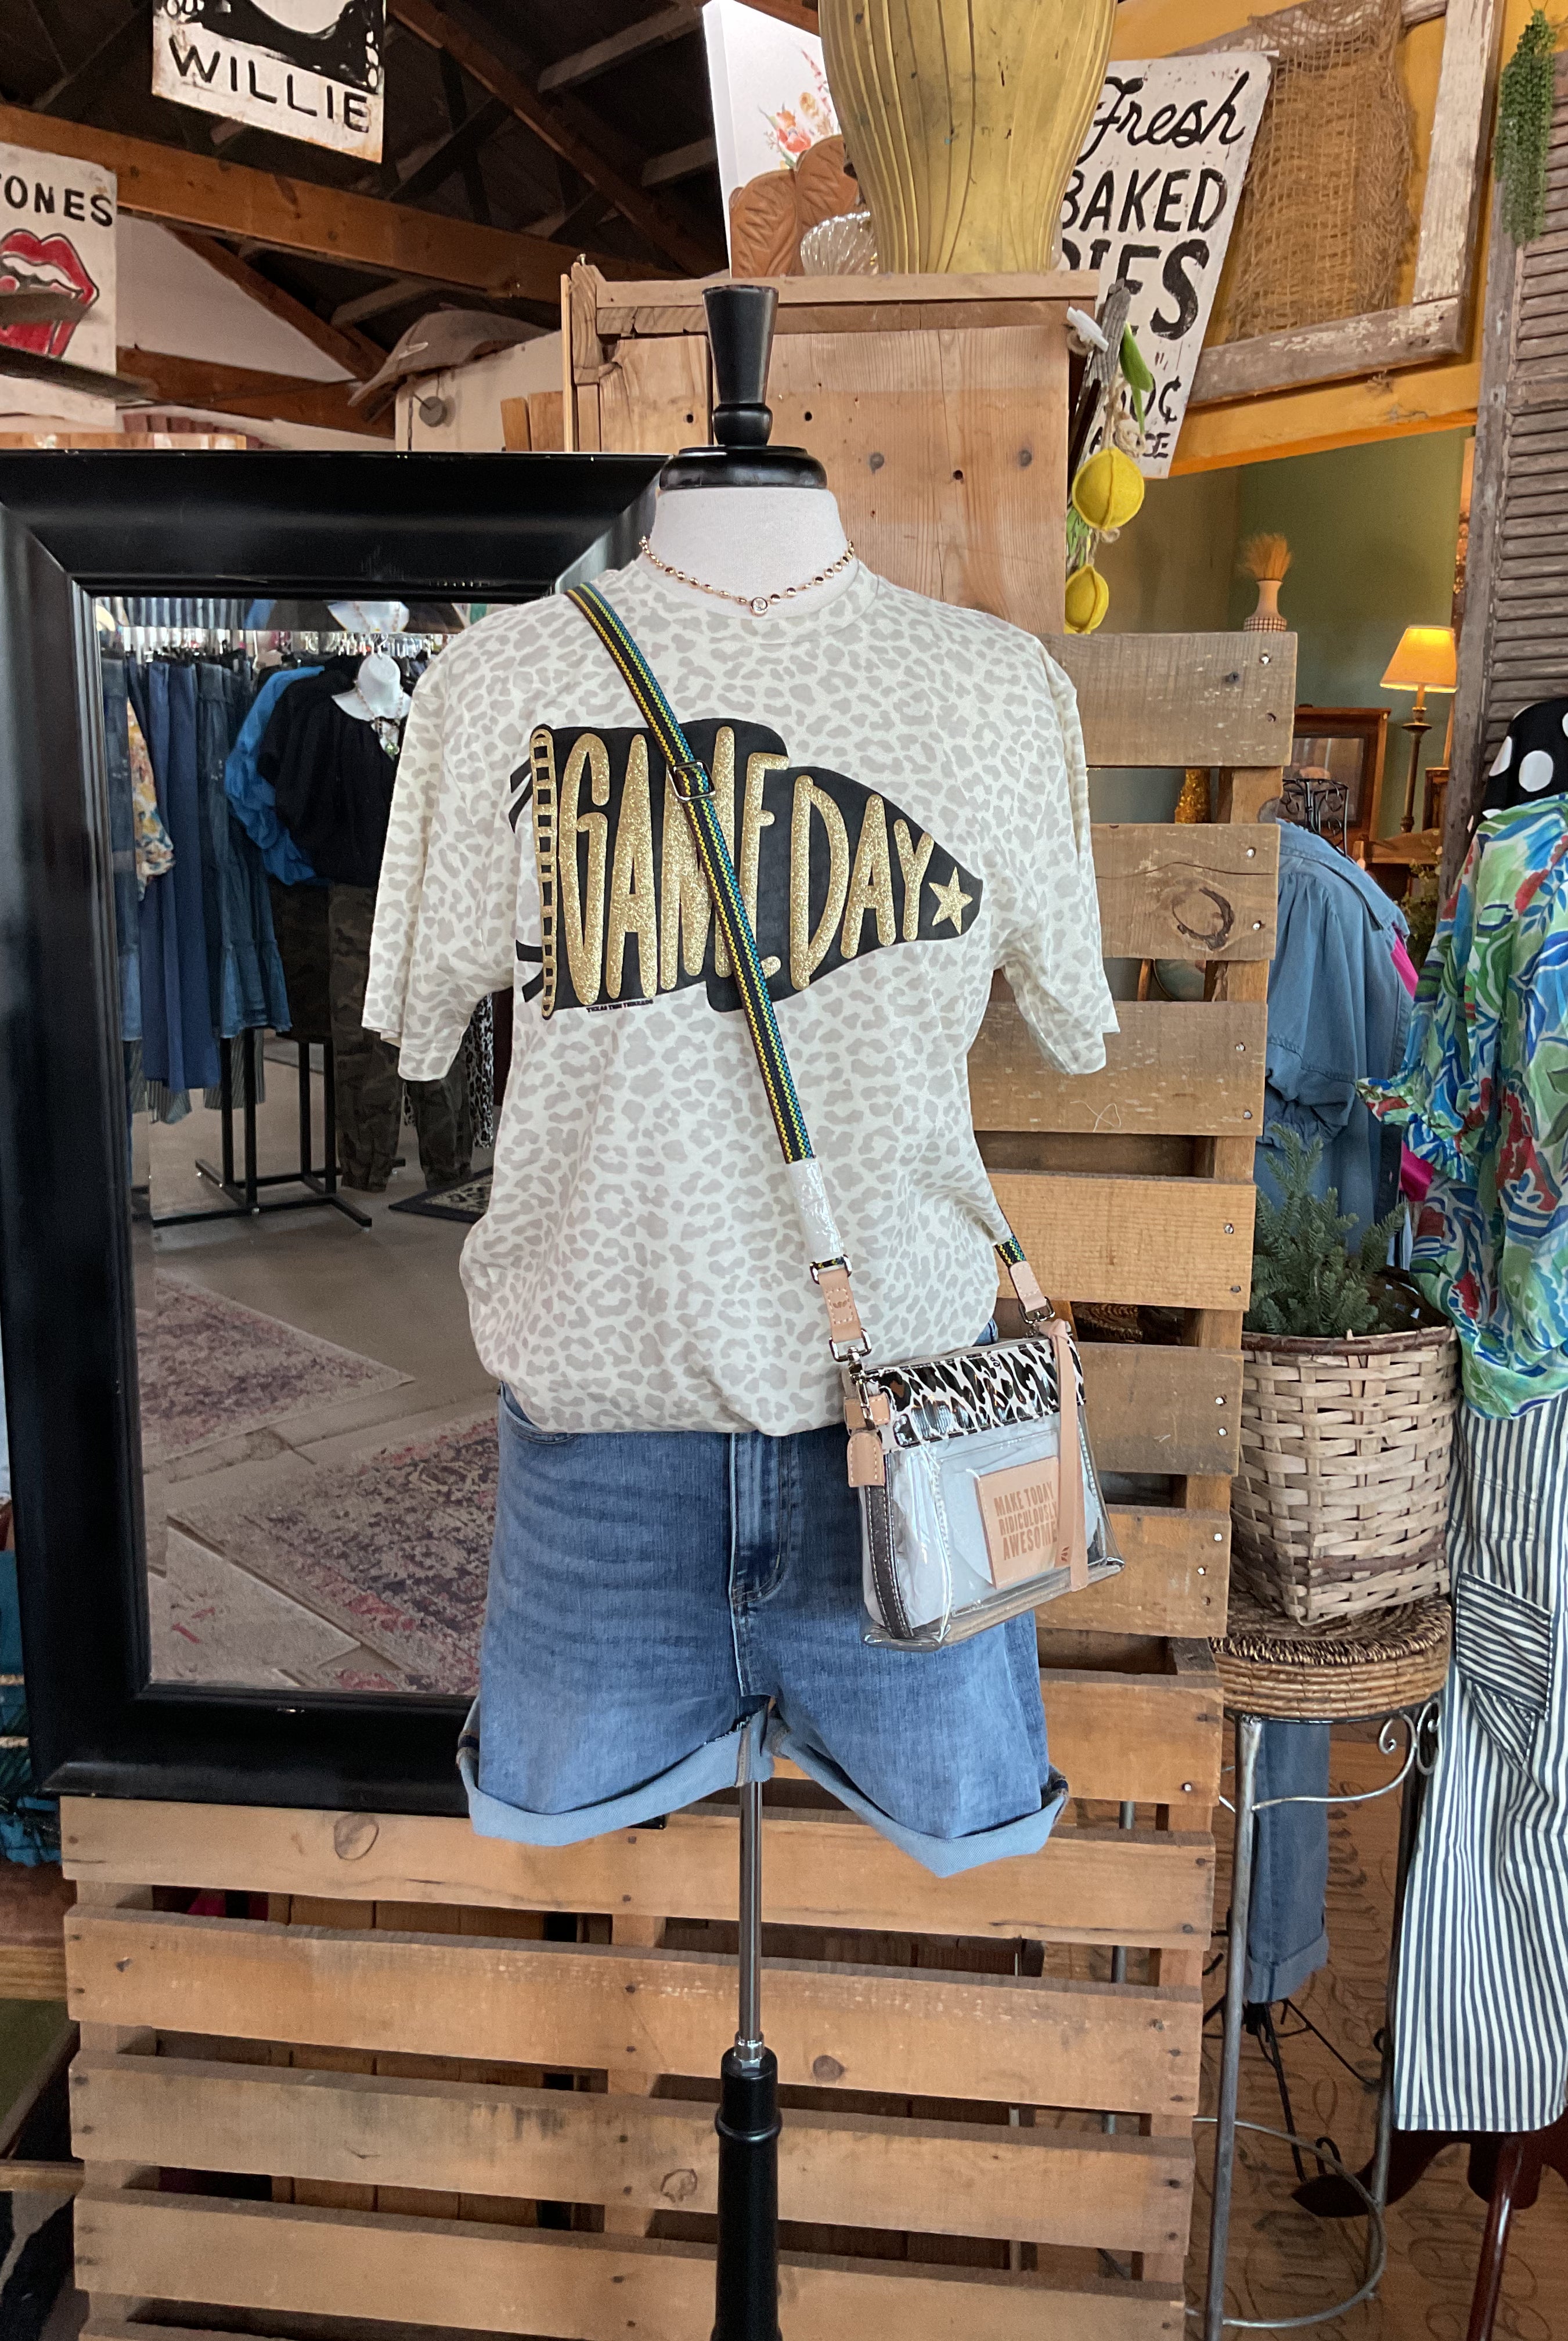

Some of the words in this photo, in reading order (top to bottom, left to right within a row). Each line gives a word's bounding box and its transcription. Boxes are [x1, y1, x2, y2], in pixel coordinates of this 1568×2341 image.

[169, 34, 369, 134] WILLIE
[1076, 70, 1249, 166] Fresh
[0, 173, 113, 227] ONES
[1062, 167, 1228, 232] BAKED
[558, 726, 789, 1006] GAME
[791, 775, 935, 991] DAY
[994, 1491, 1024, 1517] MAKE
[1023, 1481, 1054, 1507] TODAY
[998, 1501, 1057, 1536] RIDICULOUSLY
[1003, 1521, 1057, 1561] AWESOME
